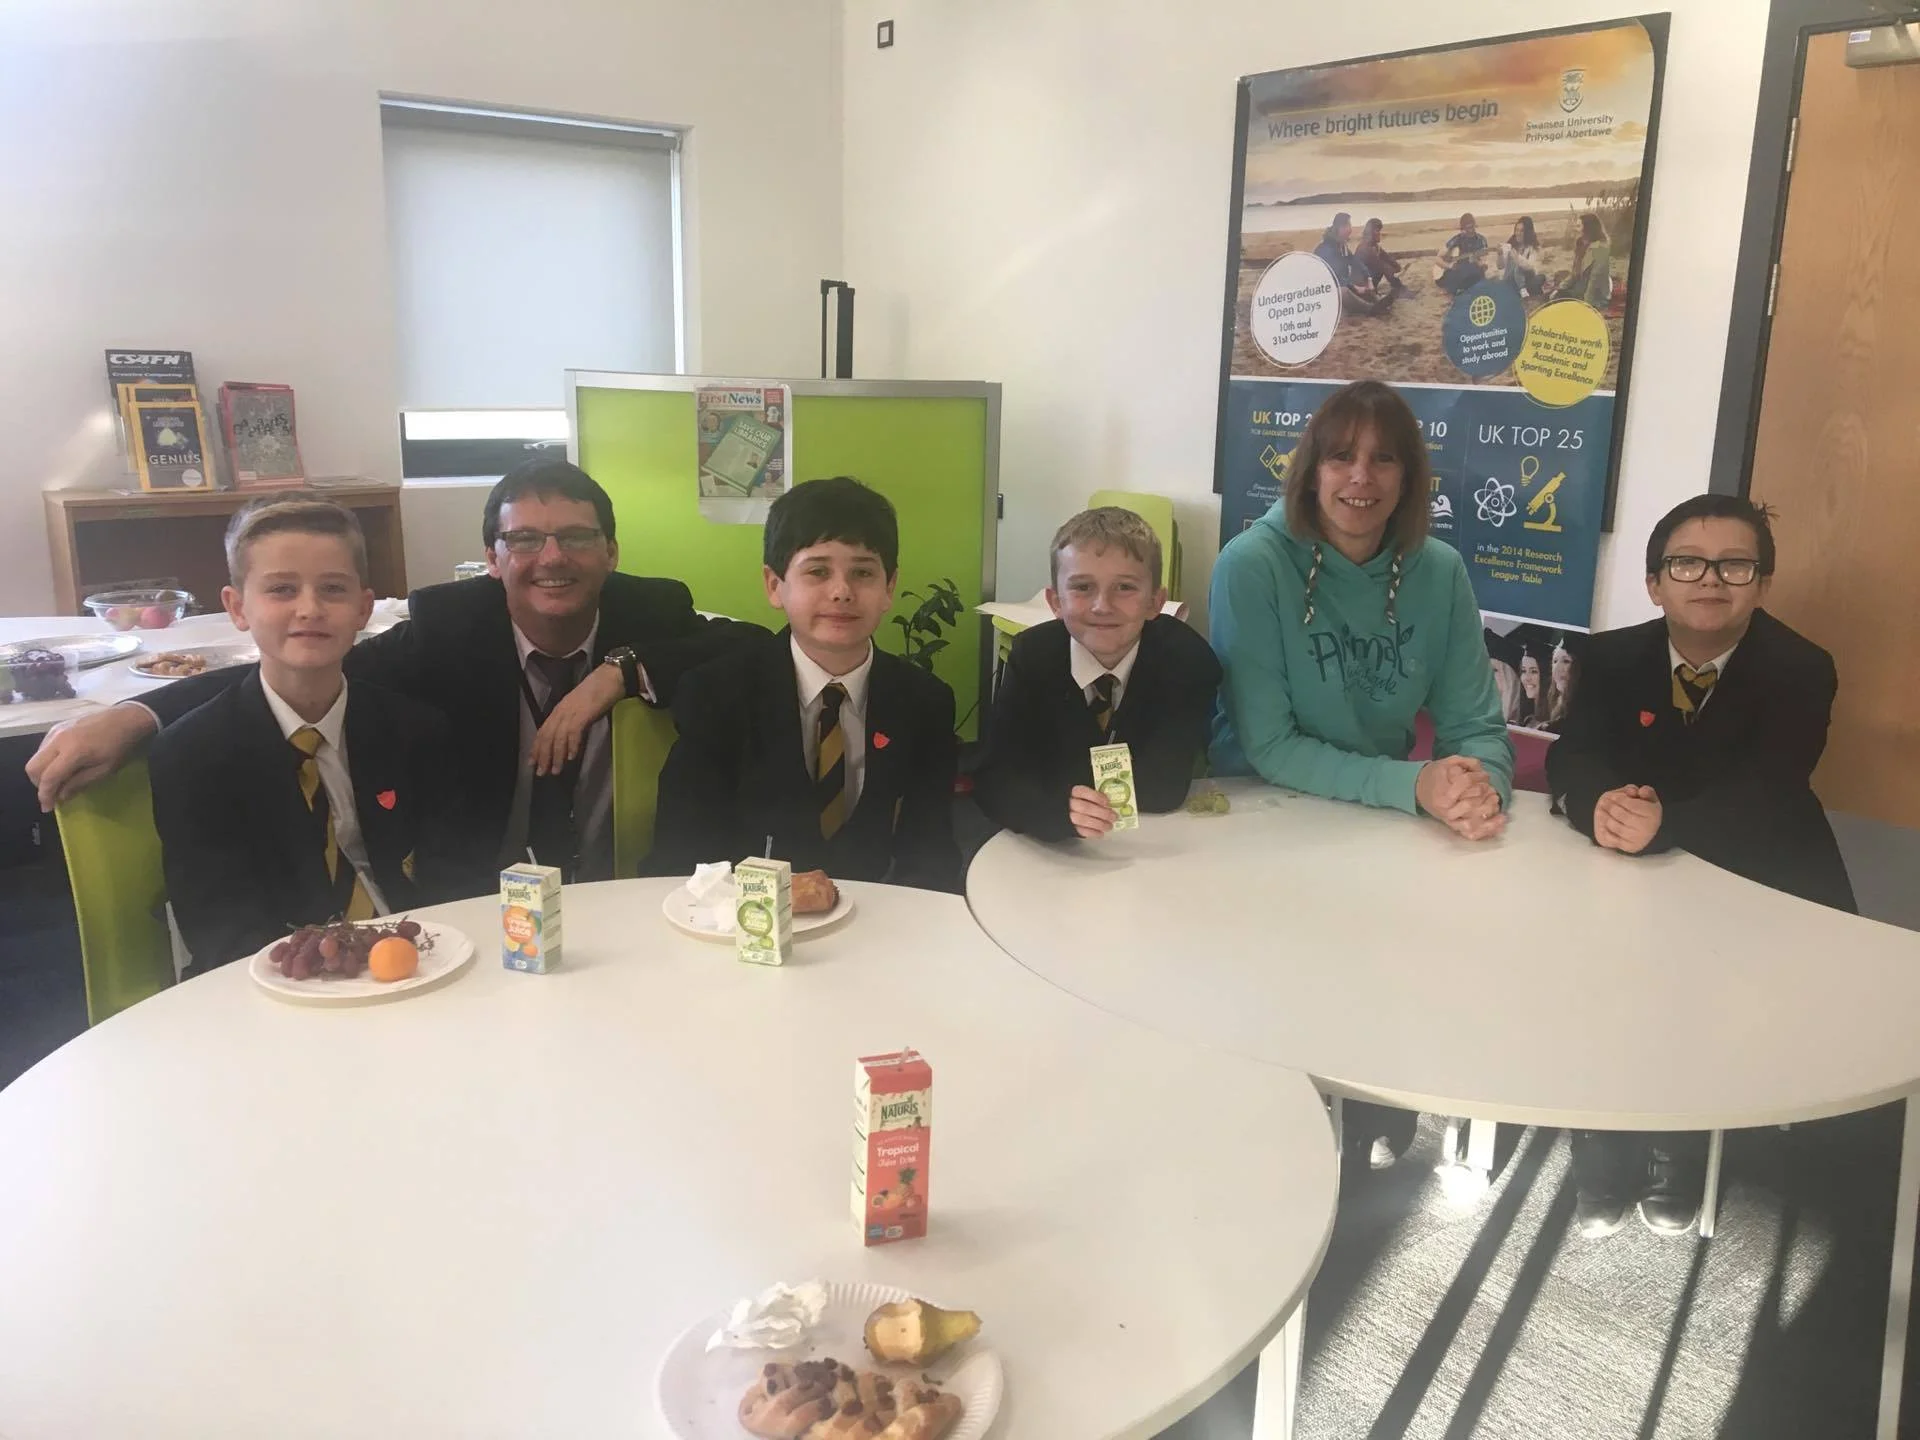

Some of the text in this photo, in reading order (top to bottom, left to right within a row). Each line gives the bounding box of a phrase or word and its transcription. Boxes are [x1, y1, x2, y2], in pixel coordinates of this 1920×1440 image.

[1268, 99, 1498, 139] Where bright futures begin
[1526, 114, 1613, 130] Swansea University
[1565, 126, 1612, 139] Abertawe
[1258, 284, 1332, 307] Undergraduate
[1268, 301, 1321, 320] Open Days
[1280, 317, 1312, 332] 10th and
[1273, 330, 1319, 345] 31st October
[1460, 328, 1508, 343] Opportunities
[1531, 325, 1578, 344] Scholarships
[1472, 340, 1489, 351] work
[1491, 336, 1506, 347] and
[1532, 341, 1542, 349] up
[1543, 341, 1551, 349] to
[1584, 348, 1595, 360] for
[109, 354, 181, 365] CS4FN
[1482, 347, 1508, 360] abroad
[1532, 351, 1588, 370] Academic and
[1520, 360, 1594, 384] Sporting Excellence
[1253, 411, 1271, 424] UK
[1275, 412, 1301, 426] TOP
[1429, 421, 1447, 438] 10
[1479, 424, 1584, 450] UK TOP 25
[149, 454, 201, 464] GENIUS
[1477, 543, 1563, 562] in the 2014 Research
[1474, 554, 1562, 575] Excellence Framework
[1491, 569, 1542, 584] League Table
[881, 1101, 919, 1121] NATURIS
[876, 1142, 920, 1158] Tropical
